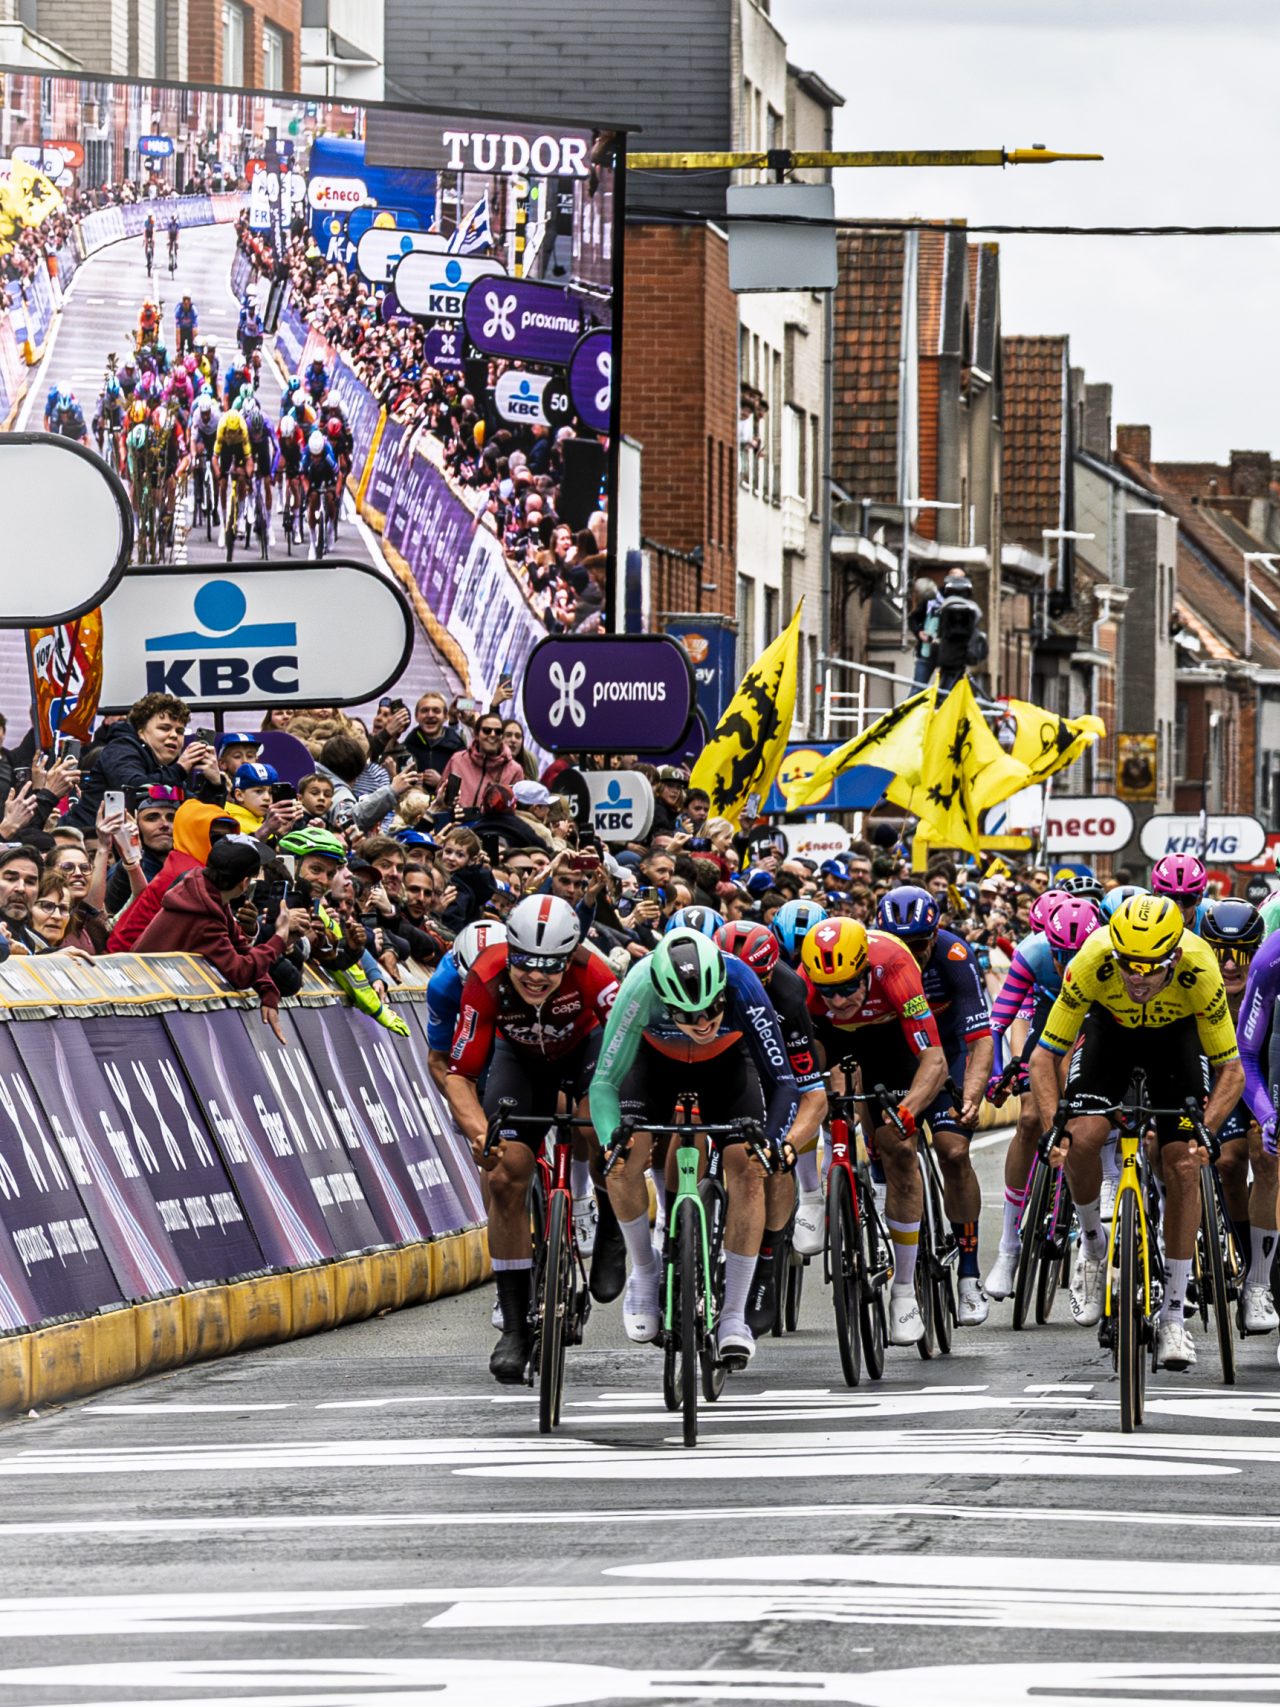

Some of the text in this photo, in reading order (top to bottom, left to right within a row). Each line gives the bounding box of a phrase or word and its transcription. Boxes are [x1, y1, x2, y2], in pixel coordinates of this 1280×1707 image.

[442, 131, 590, 176] TUDOR
[325, 187, 360, 202] Eneco
[508, 394, 568, 417] KBC 50
[146, 655, 299, 697] KBC
[593, 681, 666, 707] proximus
[595, 813, 633, 830] KBC
[1047, 818, 1116, 837] neco
[803, 839, 843, 852] Eneco
[1165, 835, 1238, 854] KPMG
[552, 1000, 581, 1015] caps
[1243, 987, 1263, 1041] GIANT
[746, 1005, 784, 1067] Adecco
[787, 1035, 809, 1047] MSC
